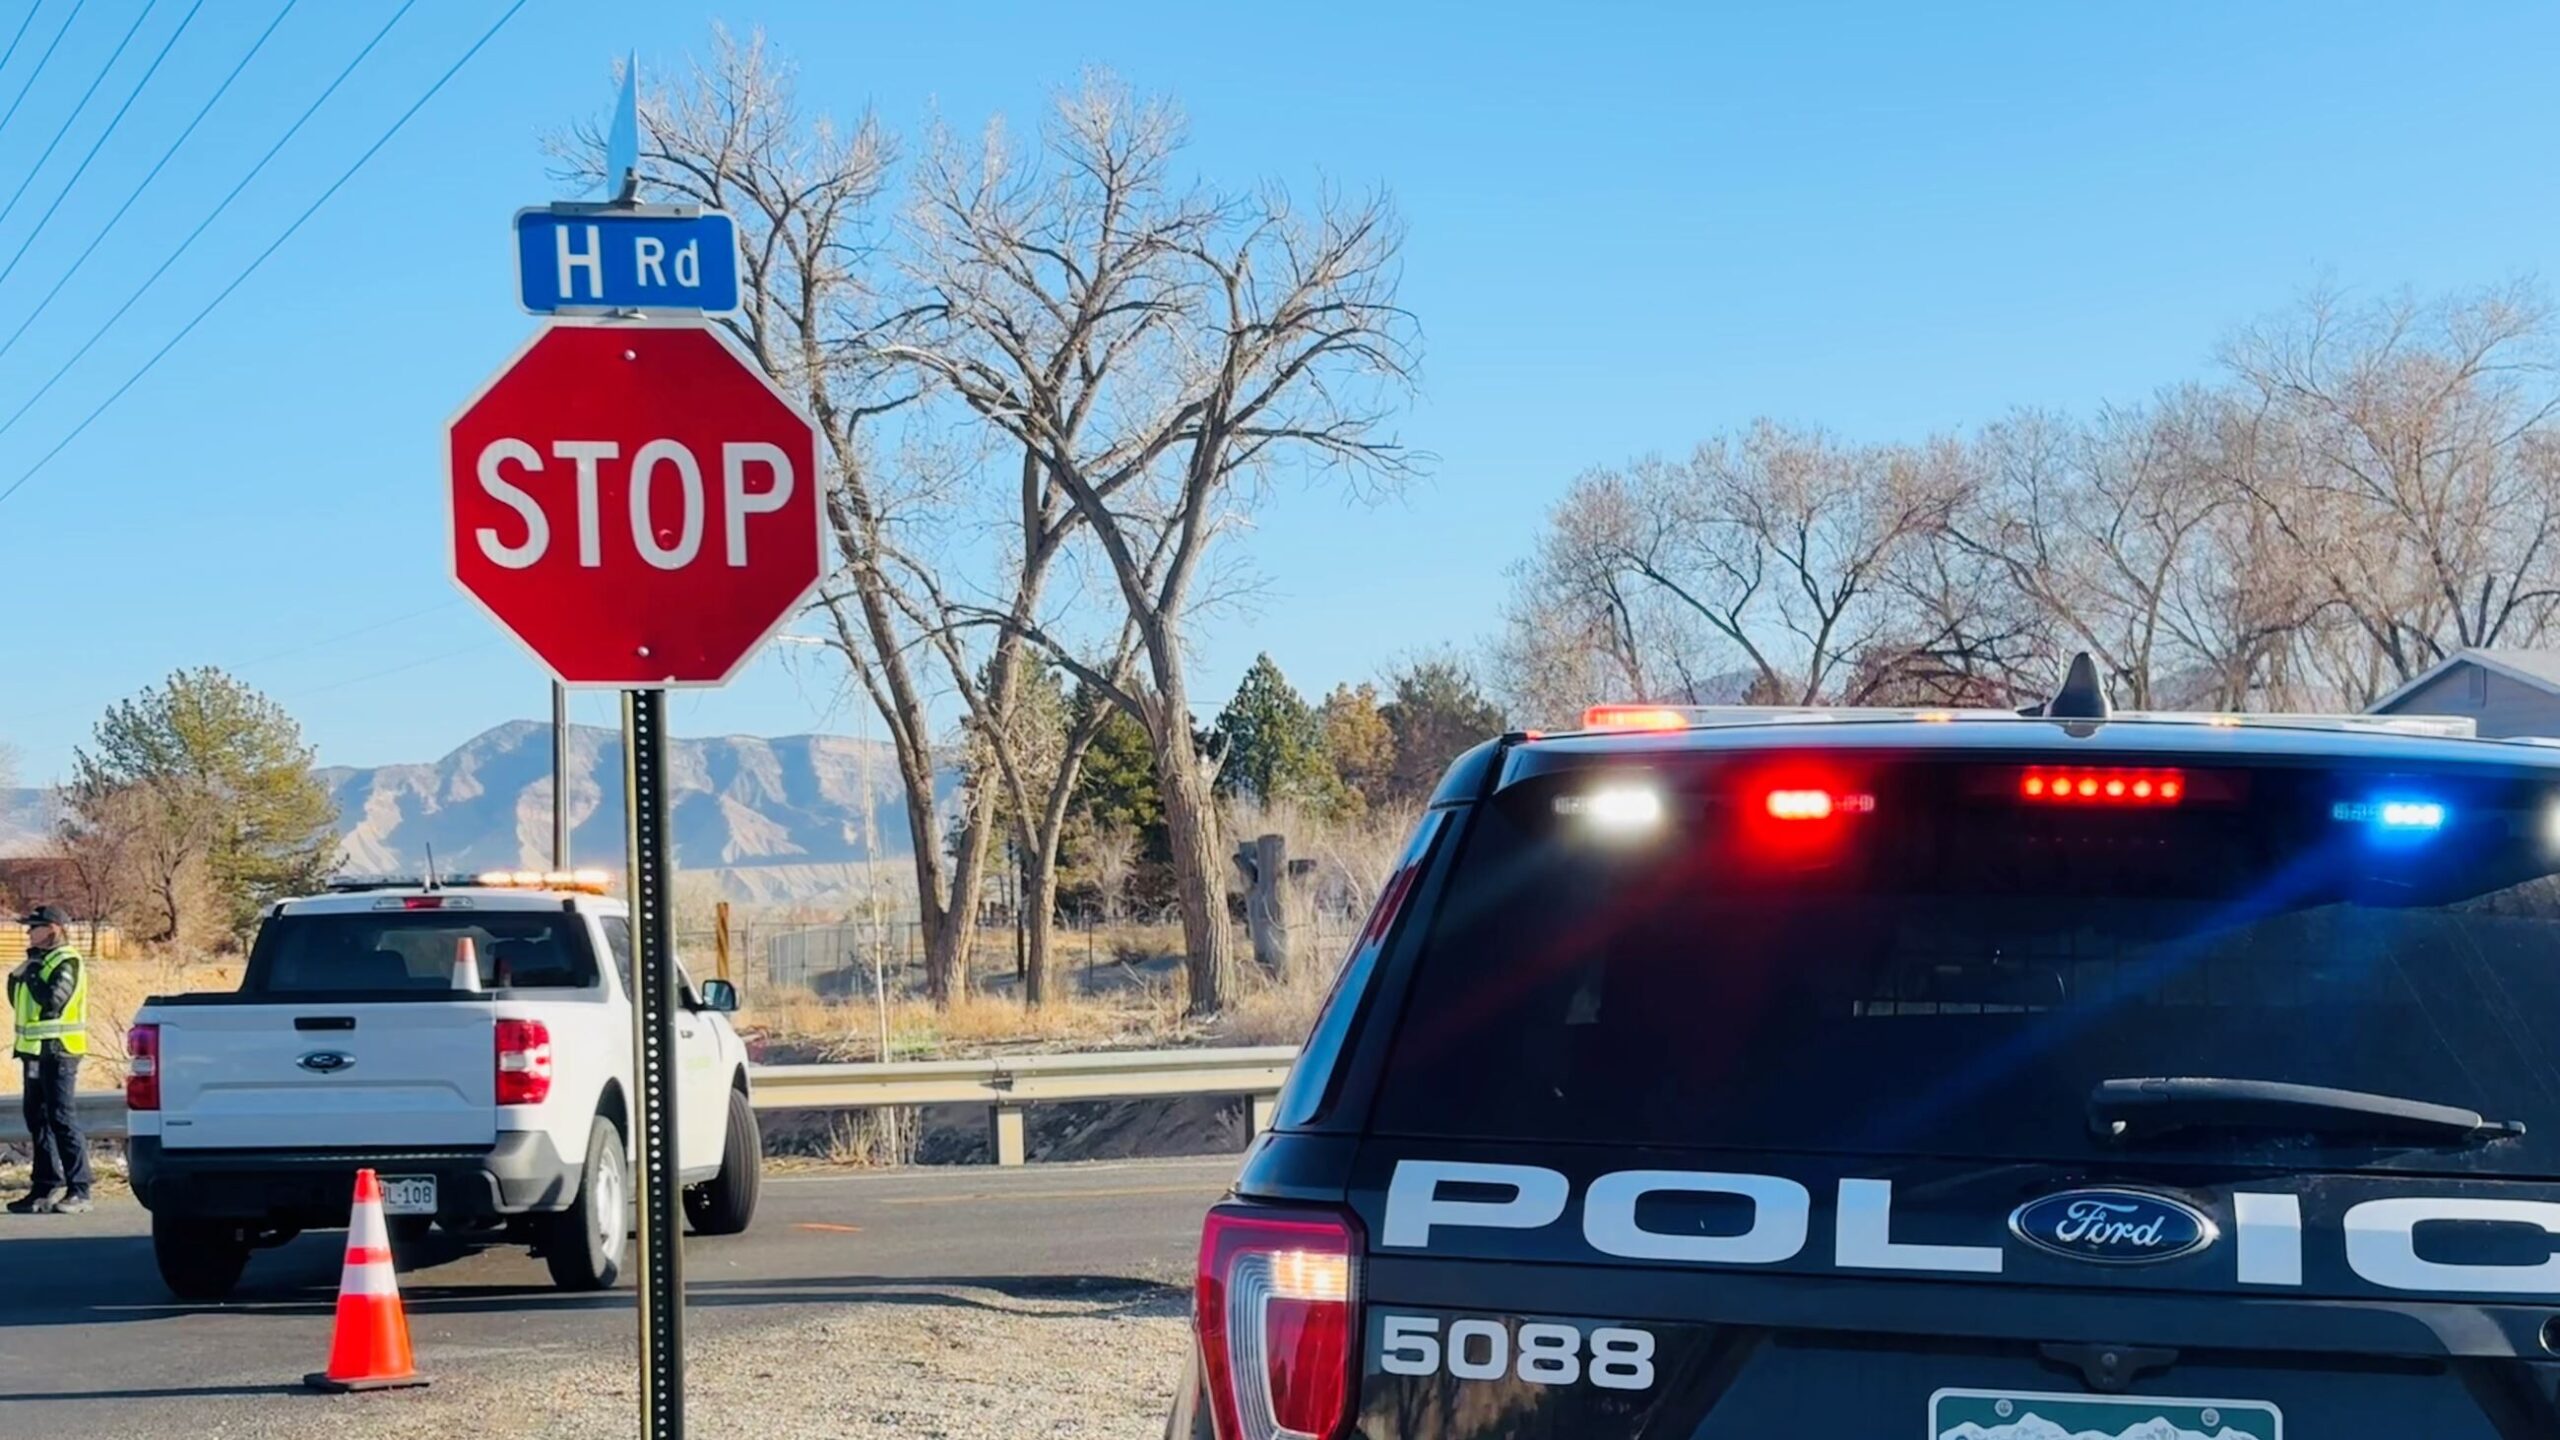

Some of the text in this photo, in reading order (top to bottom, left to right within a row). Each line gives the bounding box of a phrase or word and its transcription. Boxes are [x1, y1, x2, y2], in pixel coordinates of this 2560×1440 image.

[557, 225, 700, 297] H Rd
[475, 438, 794, 569] STOP
[2056, 1201, 2165, 1247] Ford
[1382, 1316, 1655, 1389] 5088
